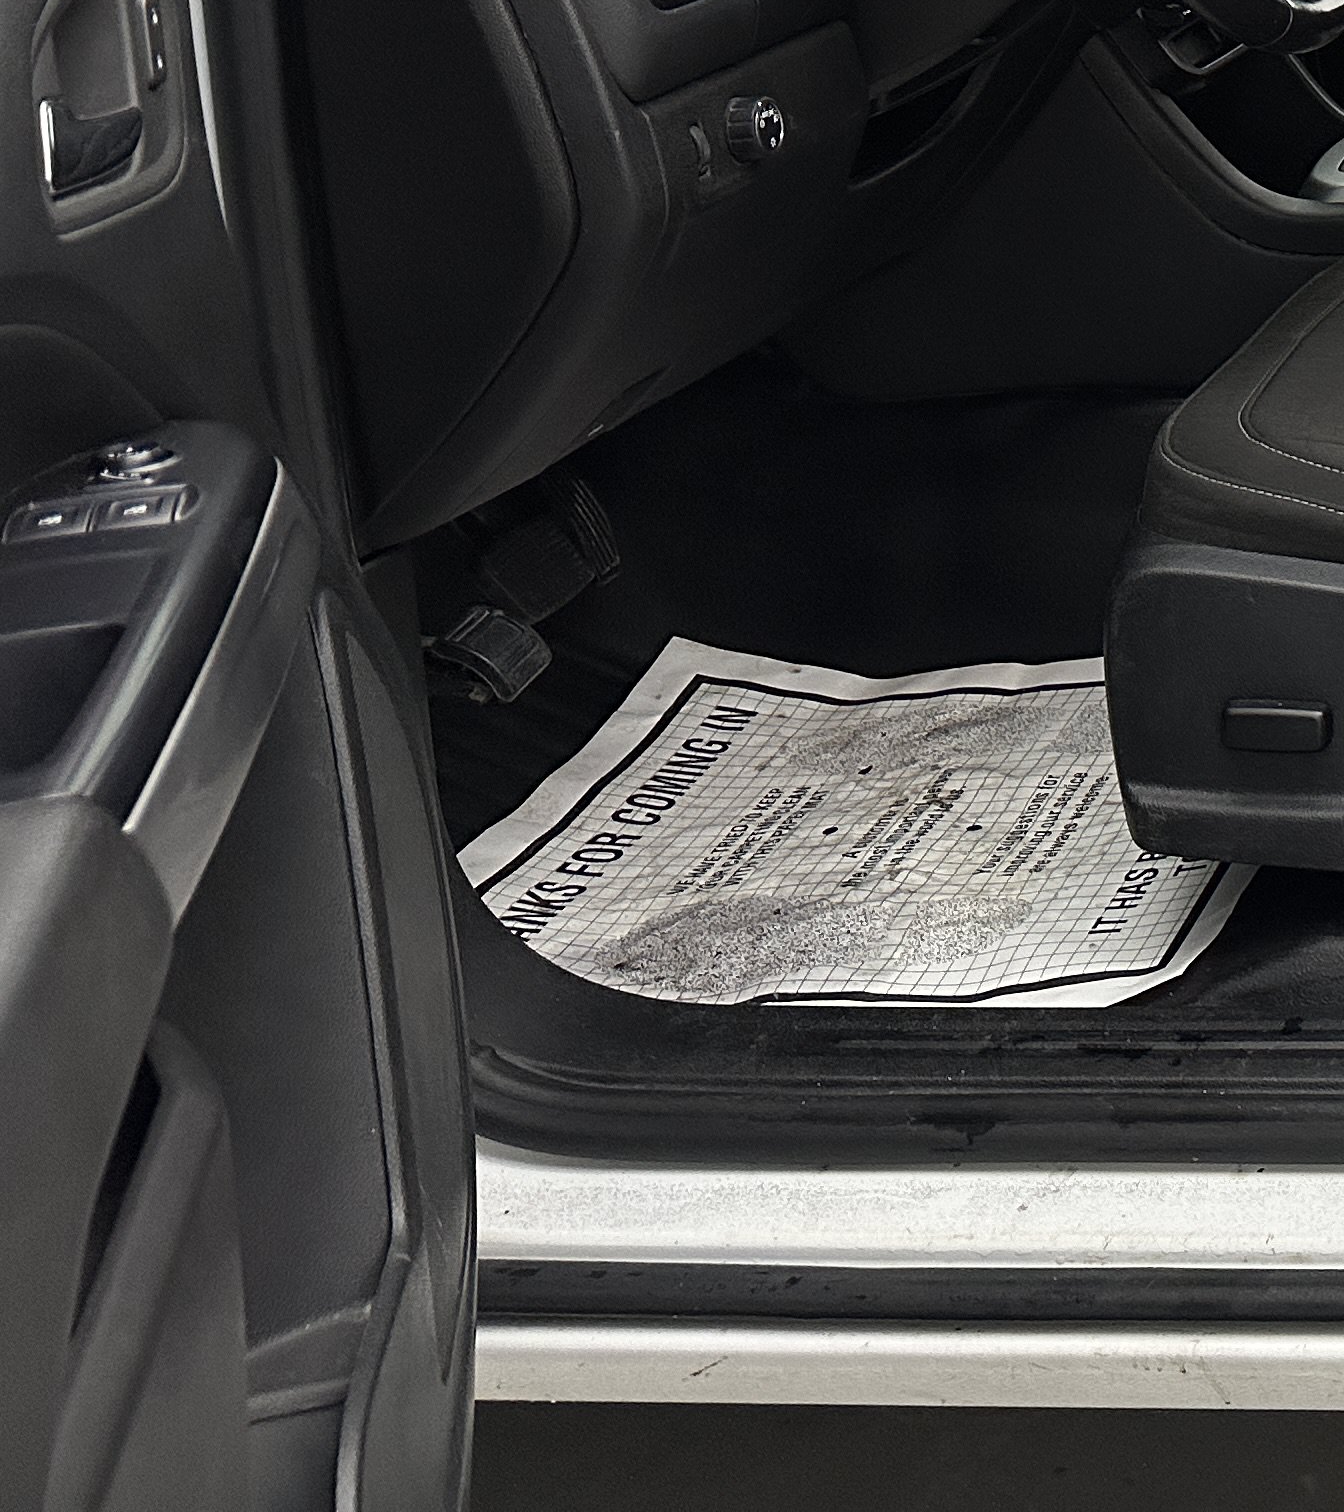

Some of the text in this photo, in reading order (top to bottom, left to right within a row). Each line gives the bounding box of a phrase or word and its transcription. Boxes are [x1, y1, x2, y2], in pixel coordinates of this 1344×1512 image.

[556, 832, 642, 877] FOR
[611, 738, 732, 826] COMING
[700, 706, 758, 731] IN
[773, 787, 811, 815] CLEAN
[1041, 810, 1061, 828] our
[1053, 772, 1088, 808] service
[666, 788, 784, 895] WE HAVE TRIED TO KEEP
[721, 861, 759, 887] WITH
[748, 838, 781, 861] THIS
[801, 790, 830, 808] MAT
[972, 774, 1061, 875] Your suggestions for
[842, 850, 861, 858] A
[860, 843, 893, 868] most
[894, 839, 920, 854] the
[1105, 867, 1159, 910] HAS
[1088, 916, 1128, 935] IT
